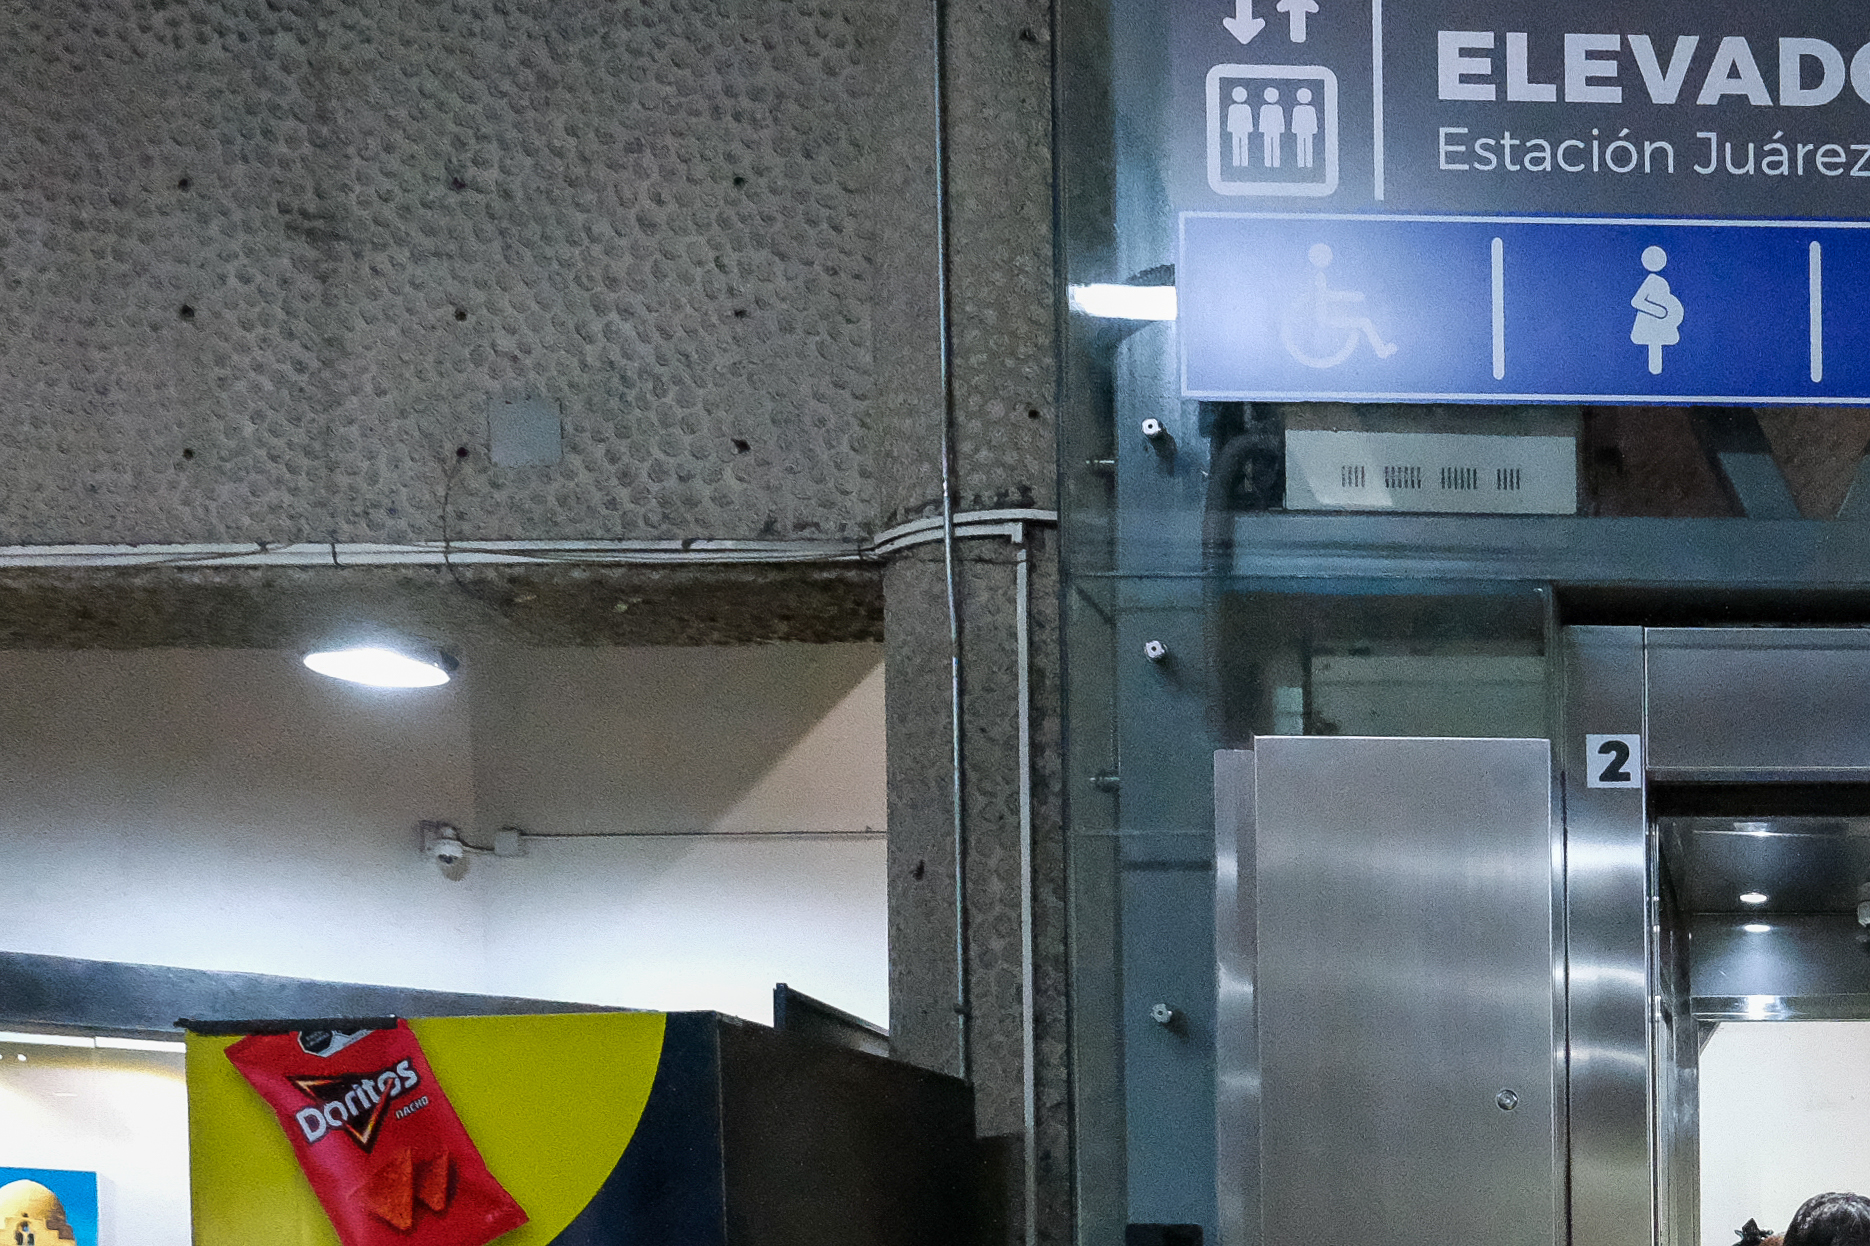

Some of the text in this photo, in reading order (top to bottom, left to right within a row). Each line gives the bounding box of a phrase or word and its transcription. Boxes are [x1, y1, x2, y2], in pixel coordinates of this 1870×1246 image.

[1437, 126, 1675, 176] Estación
[1597, 739, 1632, 782] 2
[295, 1059, 418, 1143] Doritos
